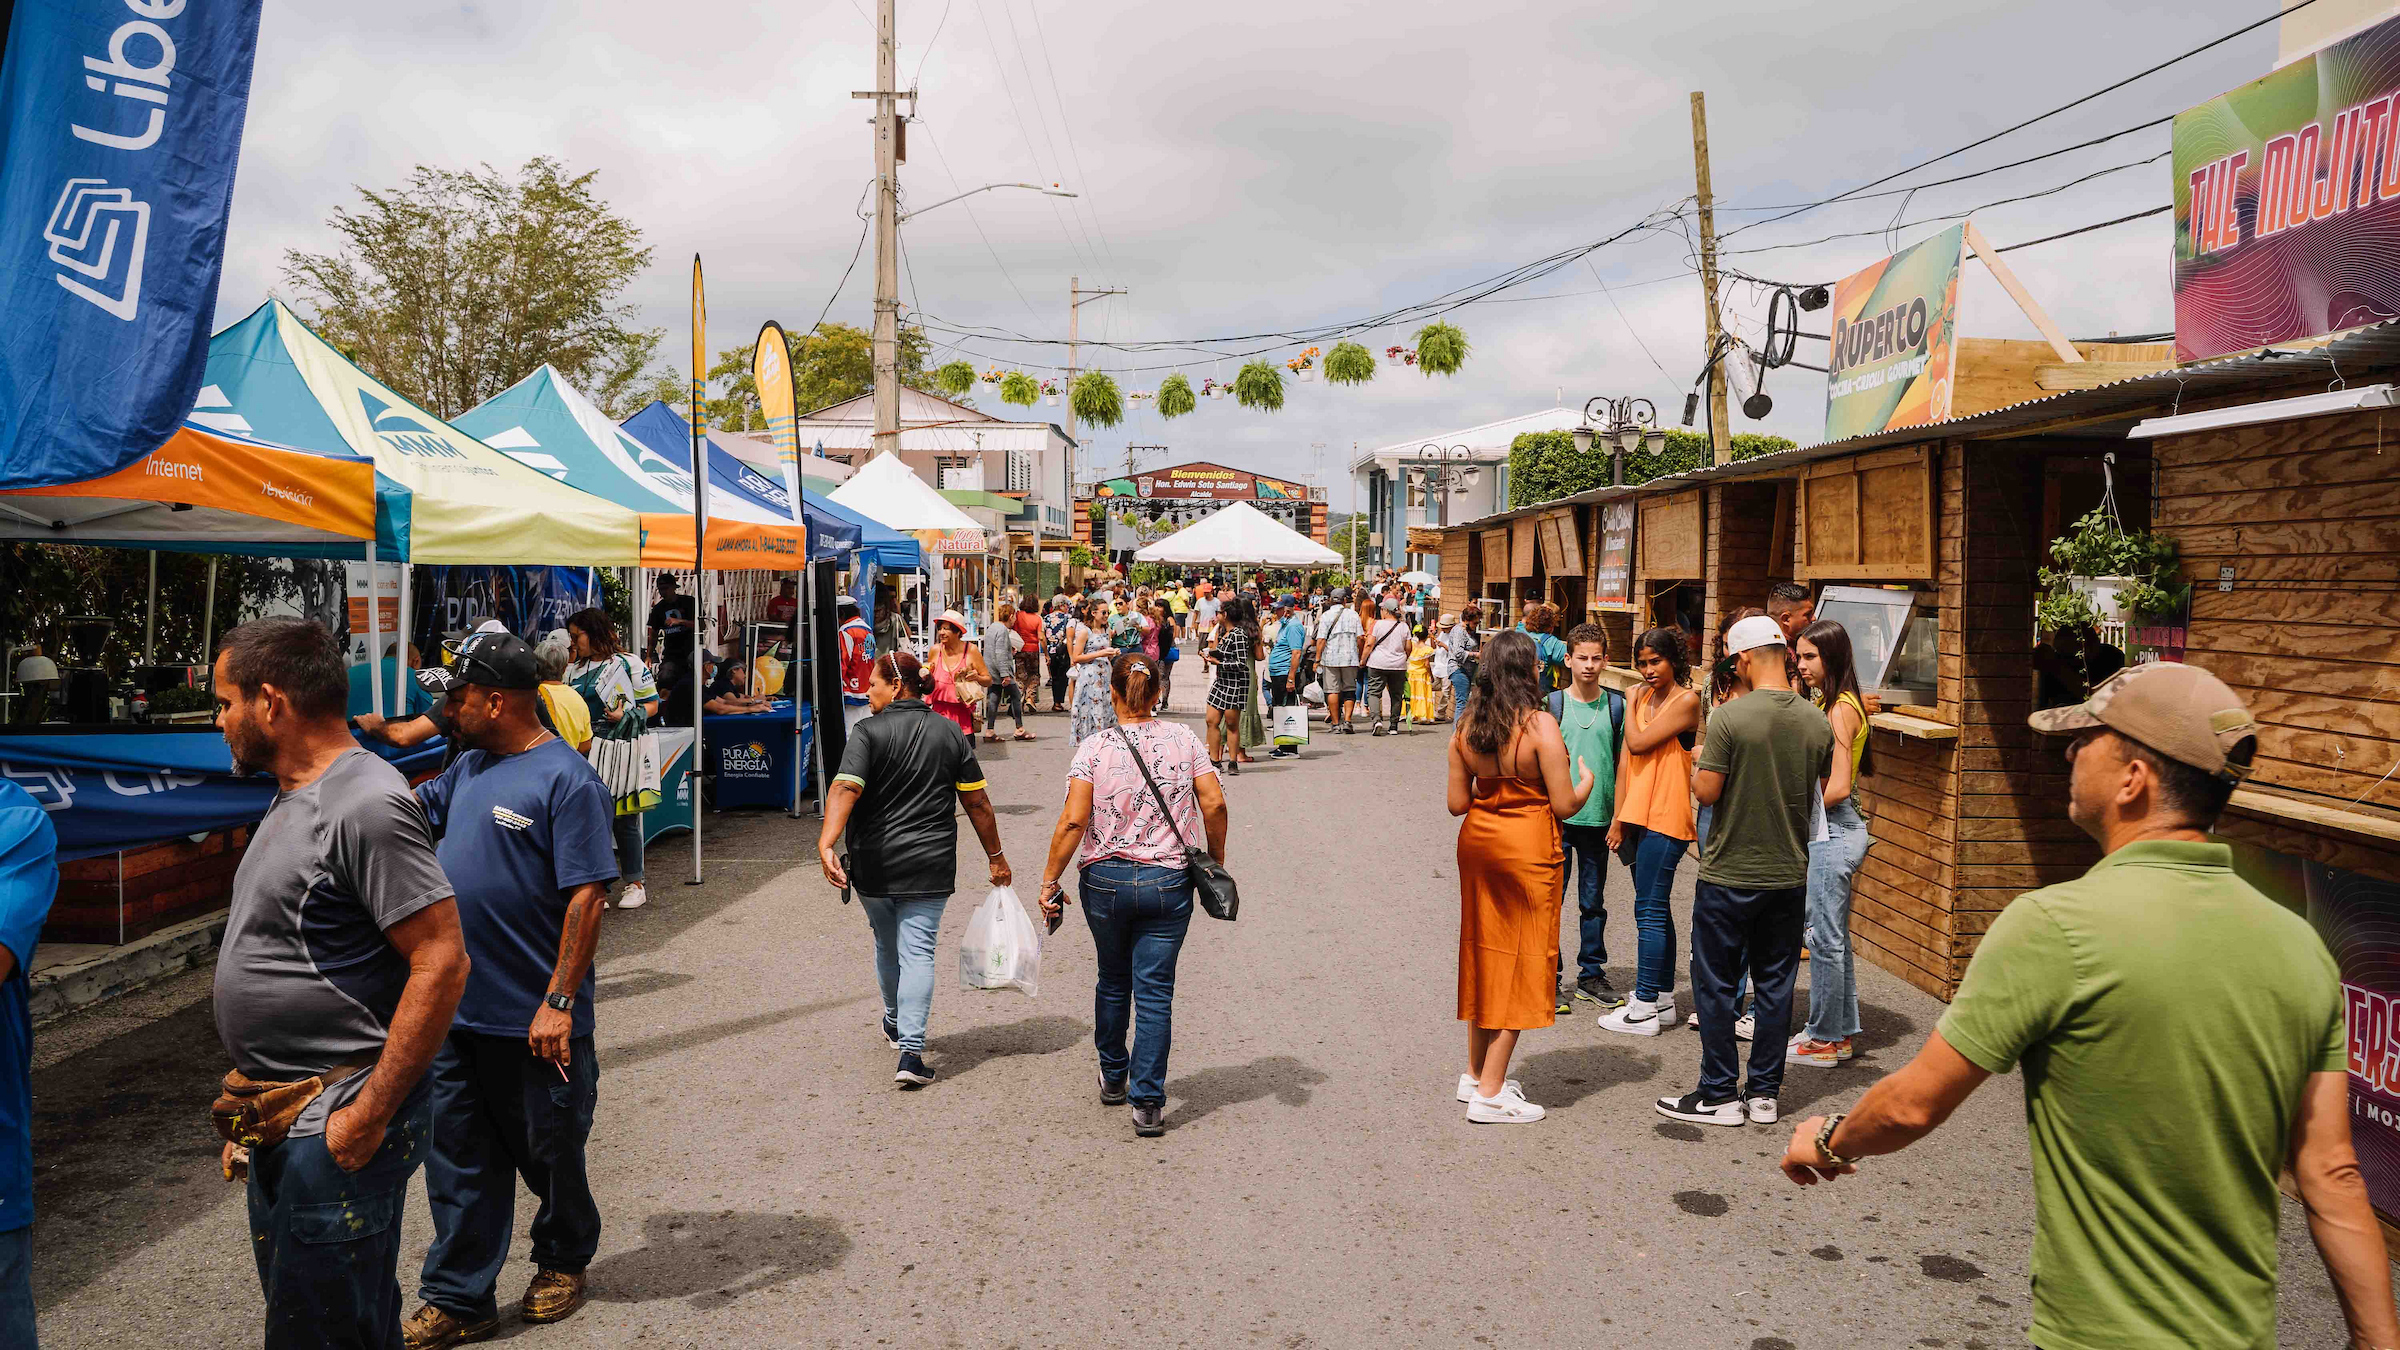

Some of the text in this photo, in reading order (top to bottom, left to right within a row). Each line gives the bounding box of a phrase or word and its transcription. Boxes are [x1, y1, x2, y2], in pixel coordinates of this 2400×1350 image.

[2187, 150, 2249, 260] THE
[1833, 295, 1927, 376] RUPERTO
[145, 454, 204, 482] Internet
[1170, 470, 1236, 480] Bienvenidos
[1155, 480, 1248, 492] Hon. Edwin Soto Santiago
[954, 529, 983, 541] 100%
[938, 539, 984, 551] Natural
[2139, 647, 2160, 664] PIÑA
[722, 748, 750, 759] PURA
